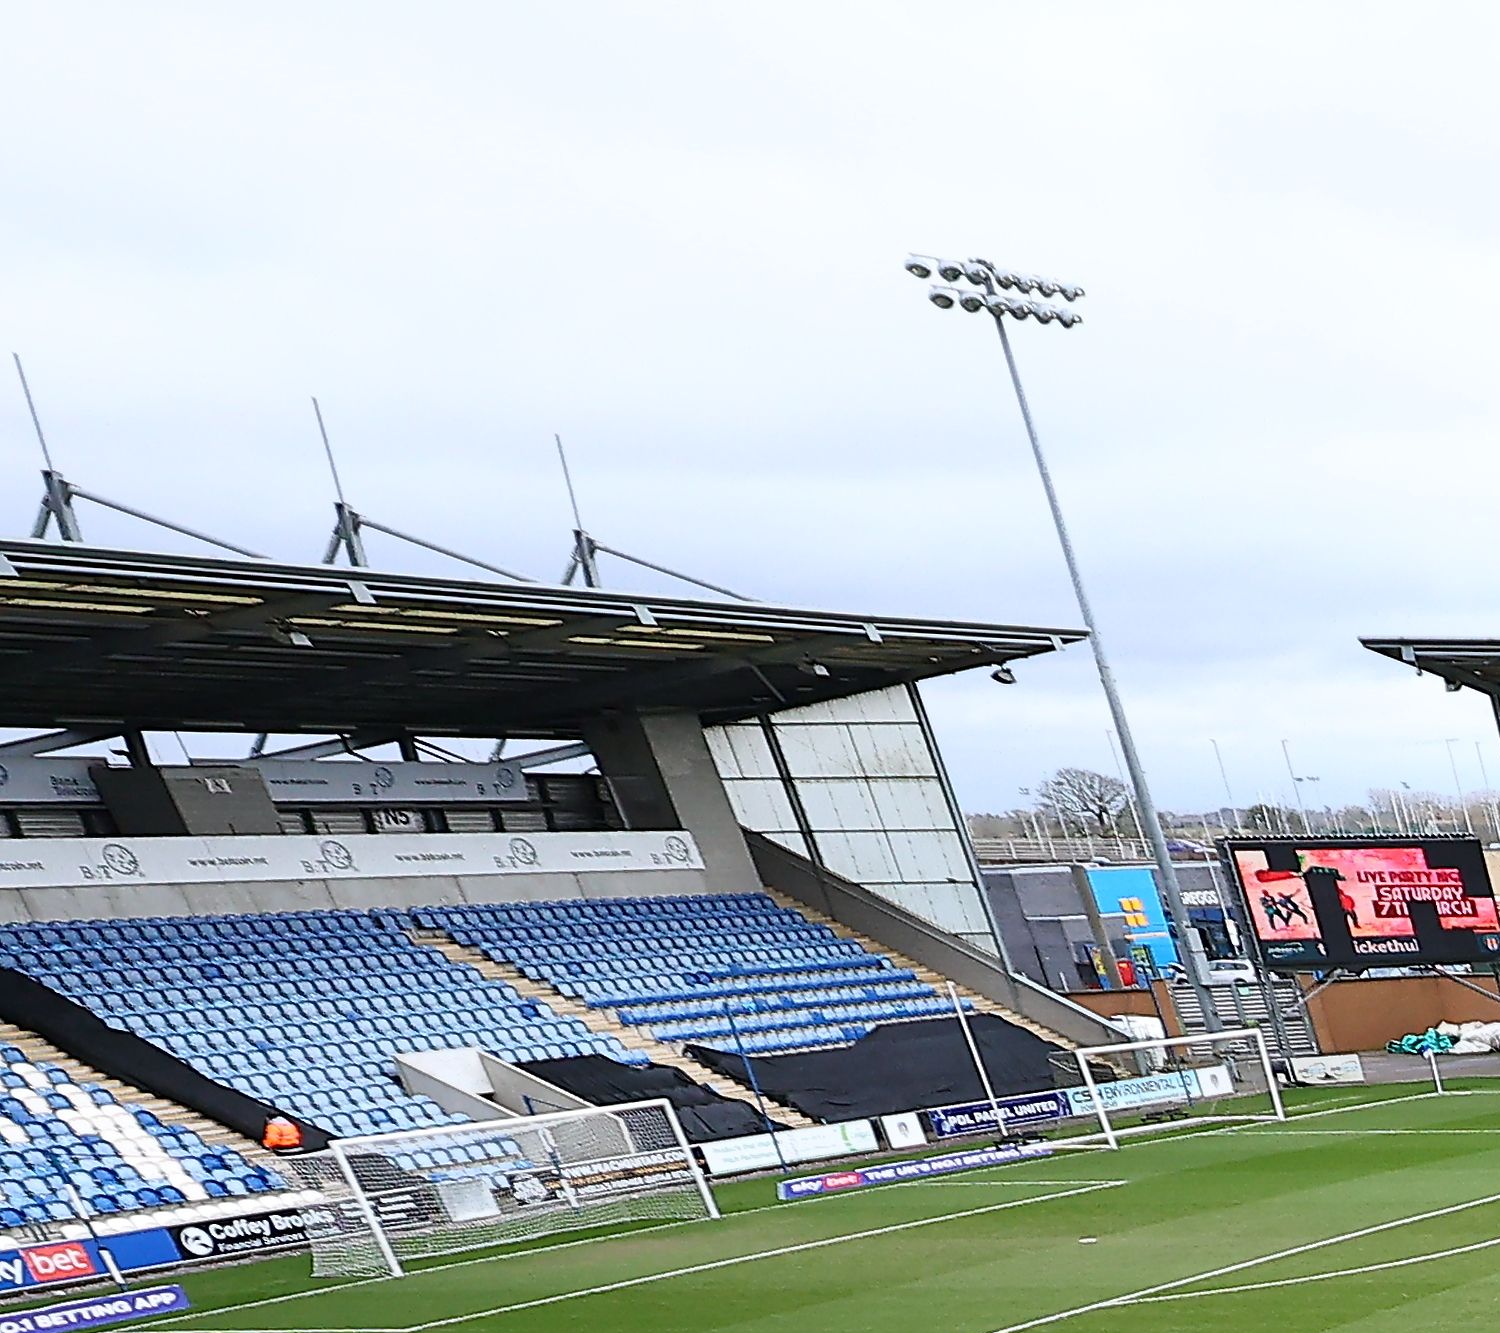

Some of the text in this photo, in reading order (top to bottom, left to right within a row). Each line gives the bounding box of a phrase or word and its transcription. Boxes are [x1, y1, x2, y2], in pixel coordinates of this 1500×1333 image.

[1356, 871, 1433, 883] LIVE PARTY
[1379, 887, 1464, 902] SATURDAY
[1014, 1100, 1058, 1118] UNITED
[790, 1168, 896, 1195] sky bet THE
[208, 1207, 337, 1240] Coffey Brooks
[29, 1247, 89, 1275] bet
[32, 1291, 177, 1330] BETTING APP
